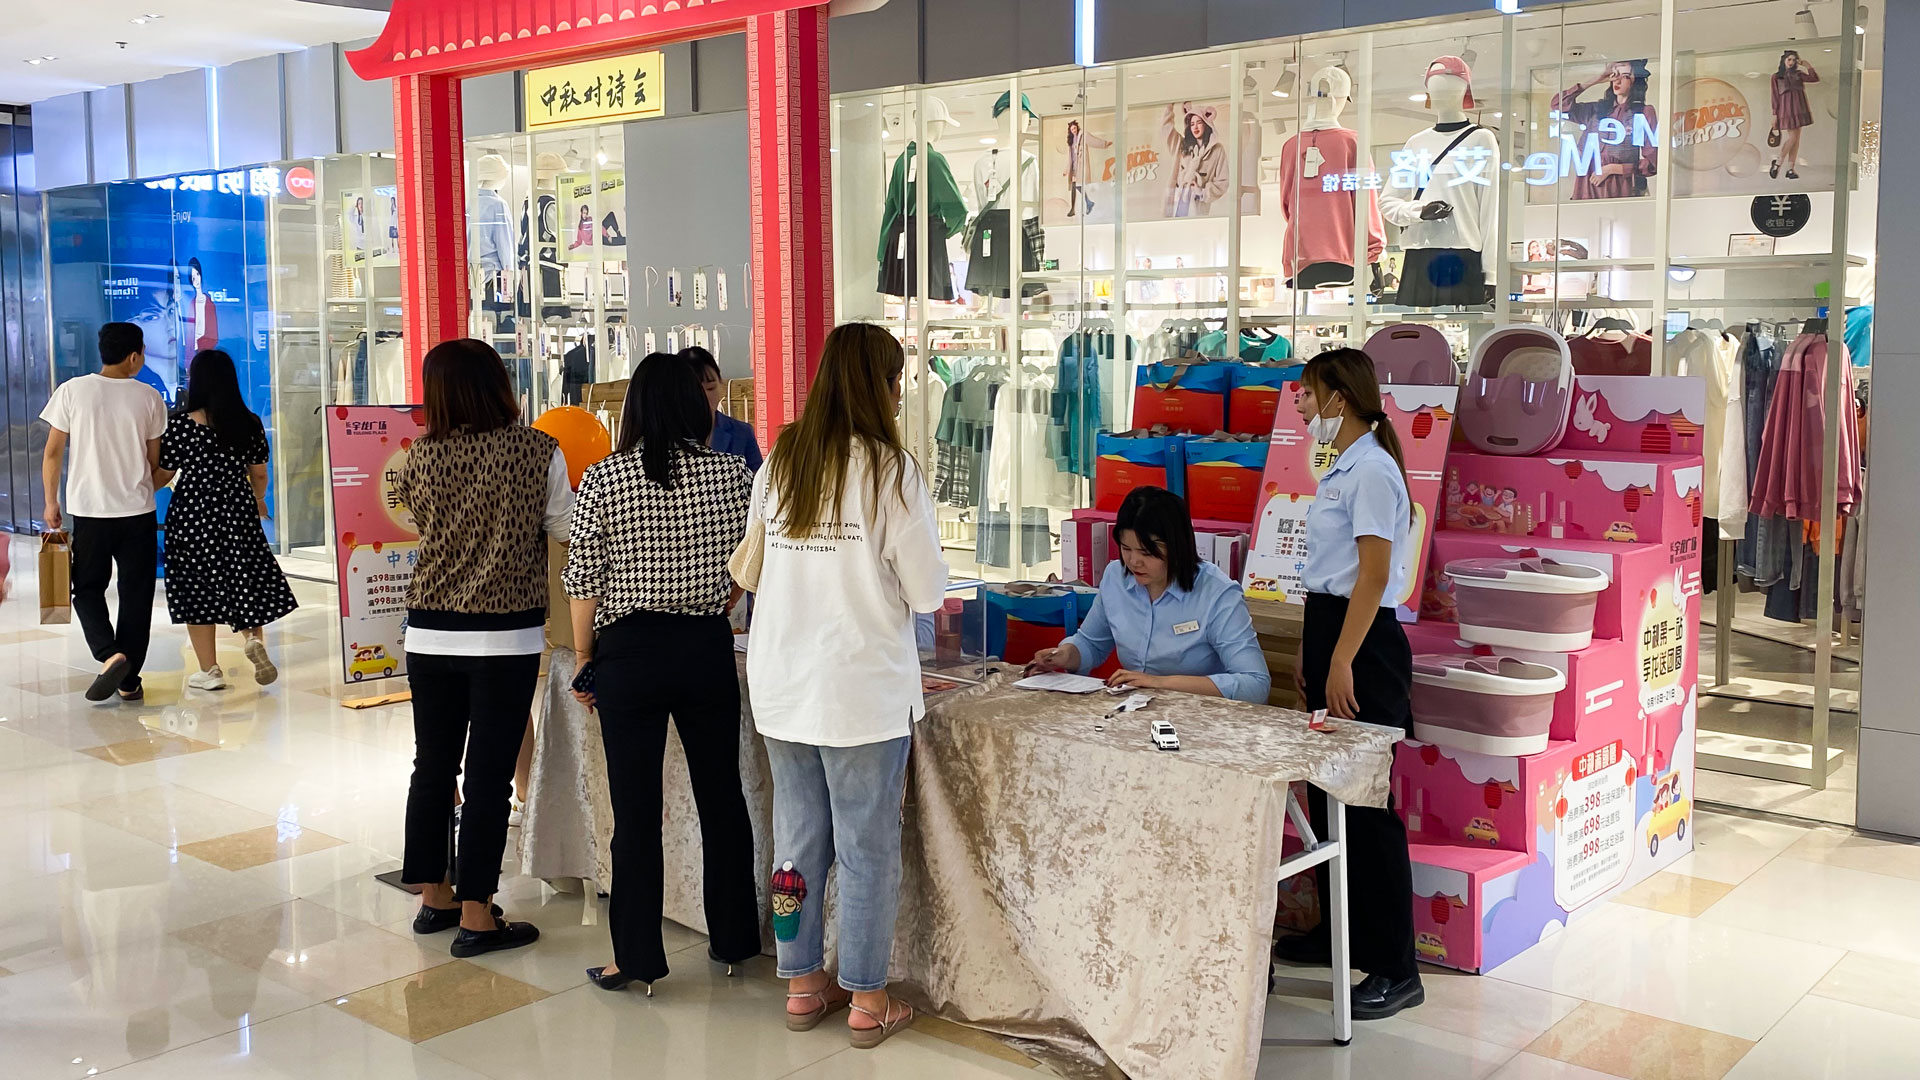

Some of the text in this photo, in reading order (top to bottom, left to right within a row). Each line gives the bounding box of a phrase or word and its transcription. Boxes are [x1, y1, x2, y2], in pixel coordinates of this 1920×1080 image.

[540, 67, 647, 117] 中秋对诗会
[1765, 218, 1796, 228] 收银台
[806, 544, 837, 553] POSSIBLE
